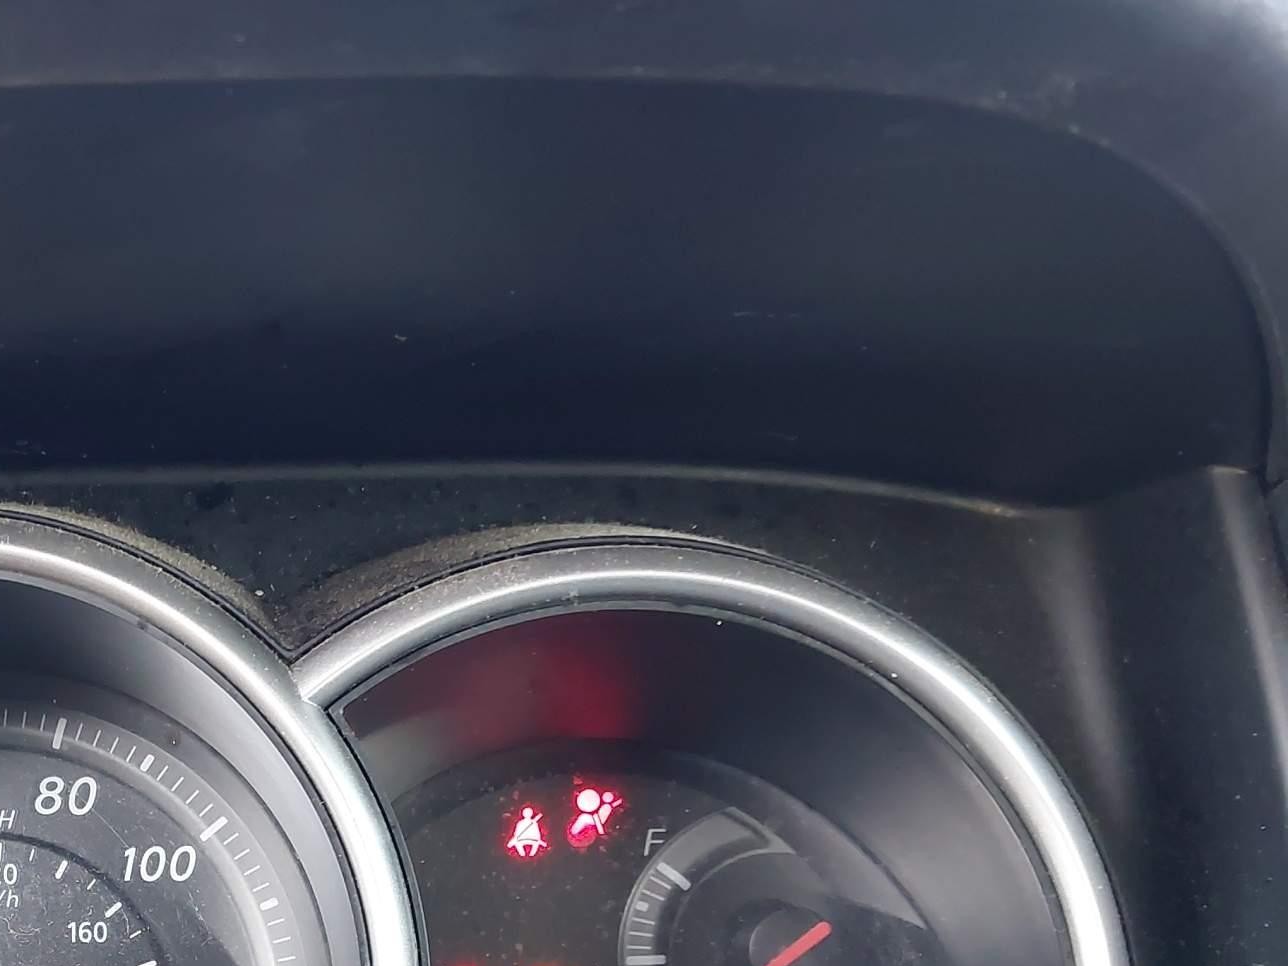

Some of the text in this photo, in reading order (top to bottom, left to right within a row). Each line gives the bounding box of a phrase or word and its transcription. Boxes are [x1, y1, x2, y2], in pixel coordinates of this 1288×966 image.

[34, 776, 97, 816] 80
[643, 828, 667, 856] F
[123, 845, 197, 882] 100
[67, 922, 108, 943] 160
